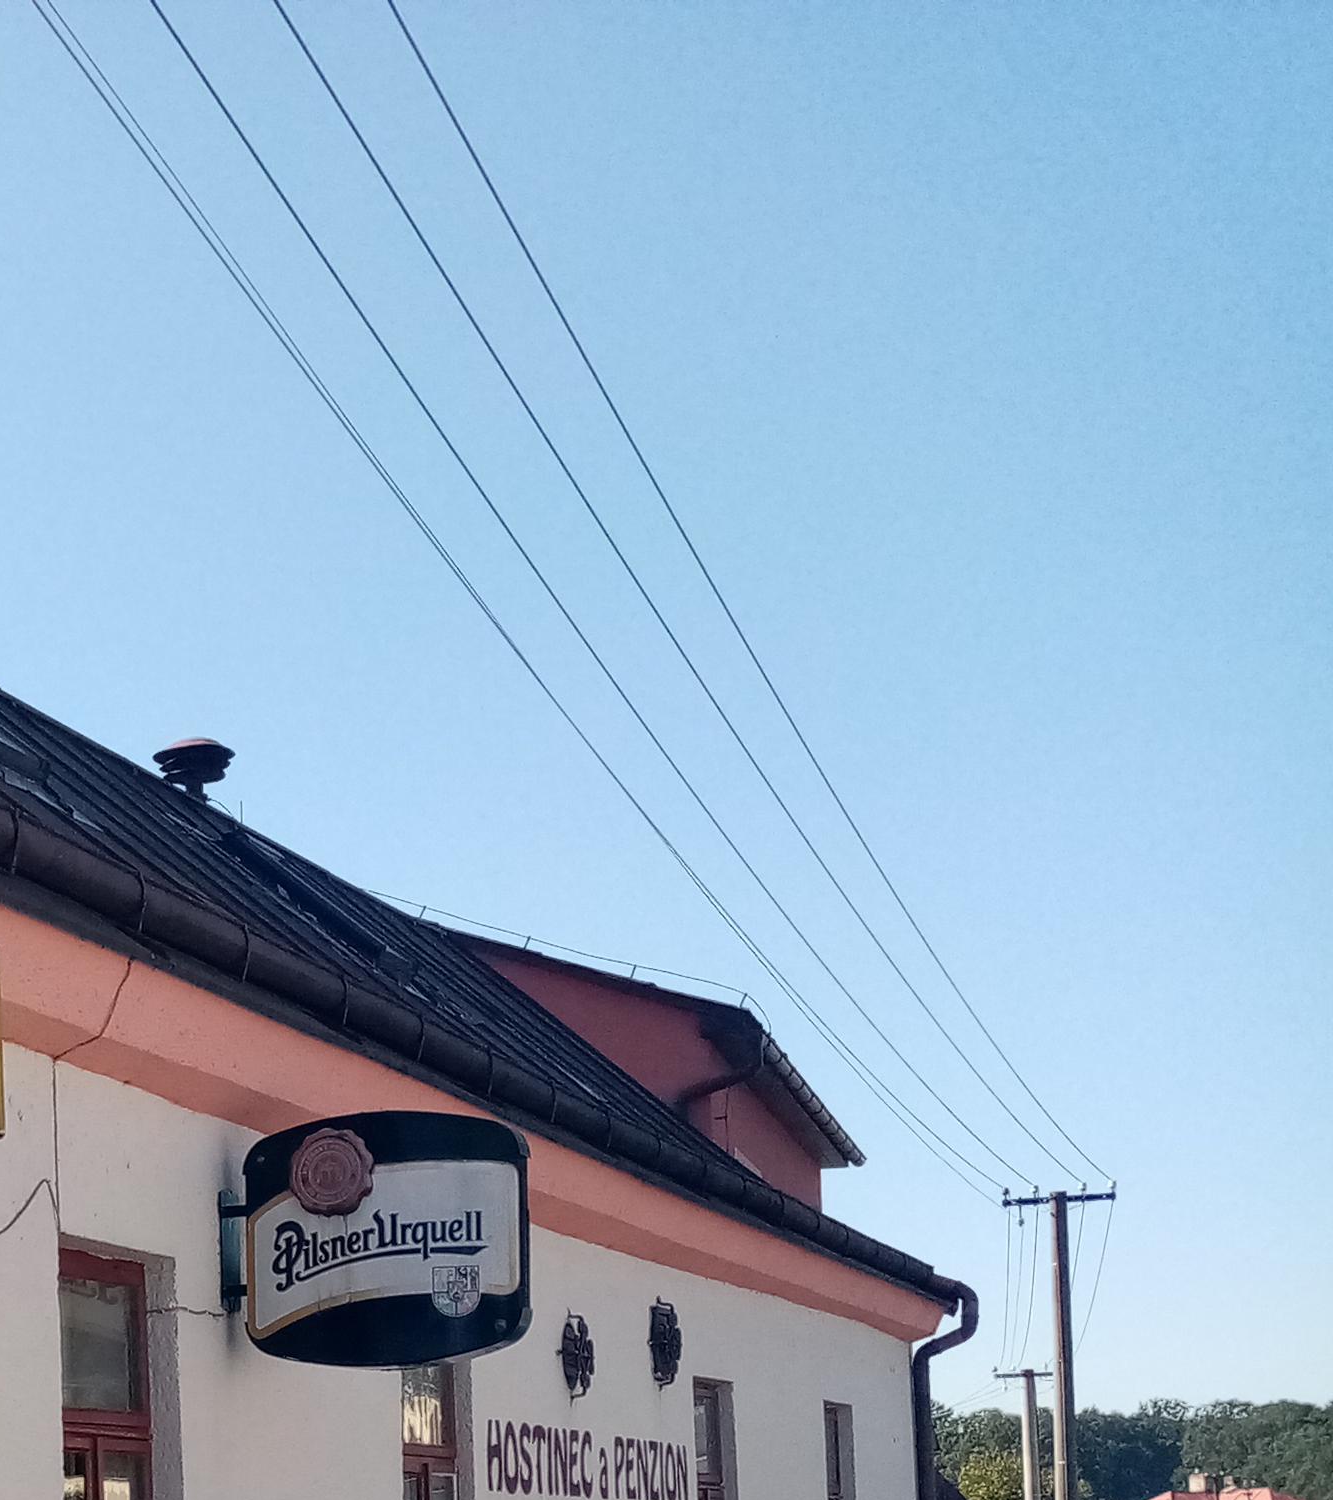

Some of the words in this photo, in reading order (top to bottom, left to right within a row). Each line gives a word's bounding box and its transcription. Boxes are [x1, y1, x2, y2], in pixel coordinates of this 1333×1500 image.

[272, 1220, 377, 1292] Pilsner
[372, 1208, 484, 1261] Urquell
[487, 1418, 594, 1499] HOSTINEC
[599, 1447, 610, 1500] a
